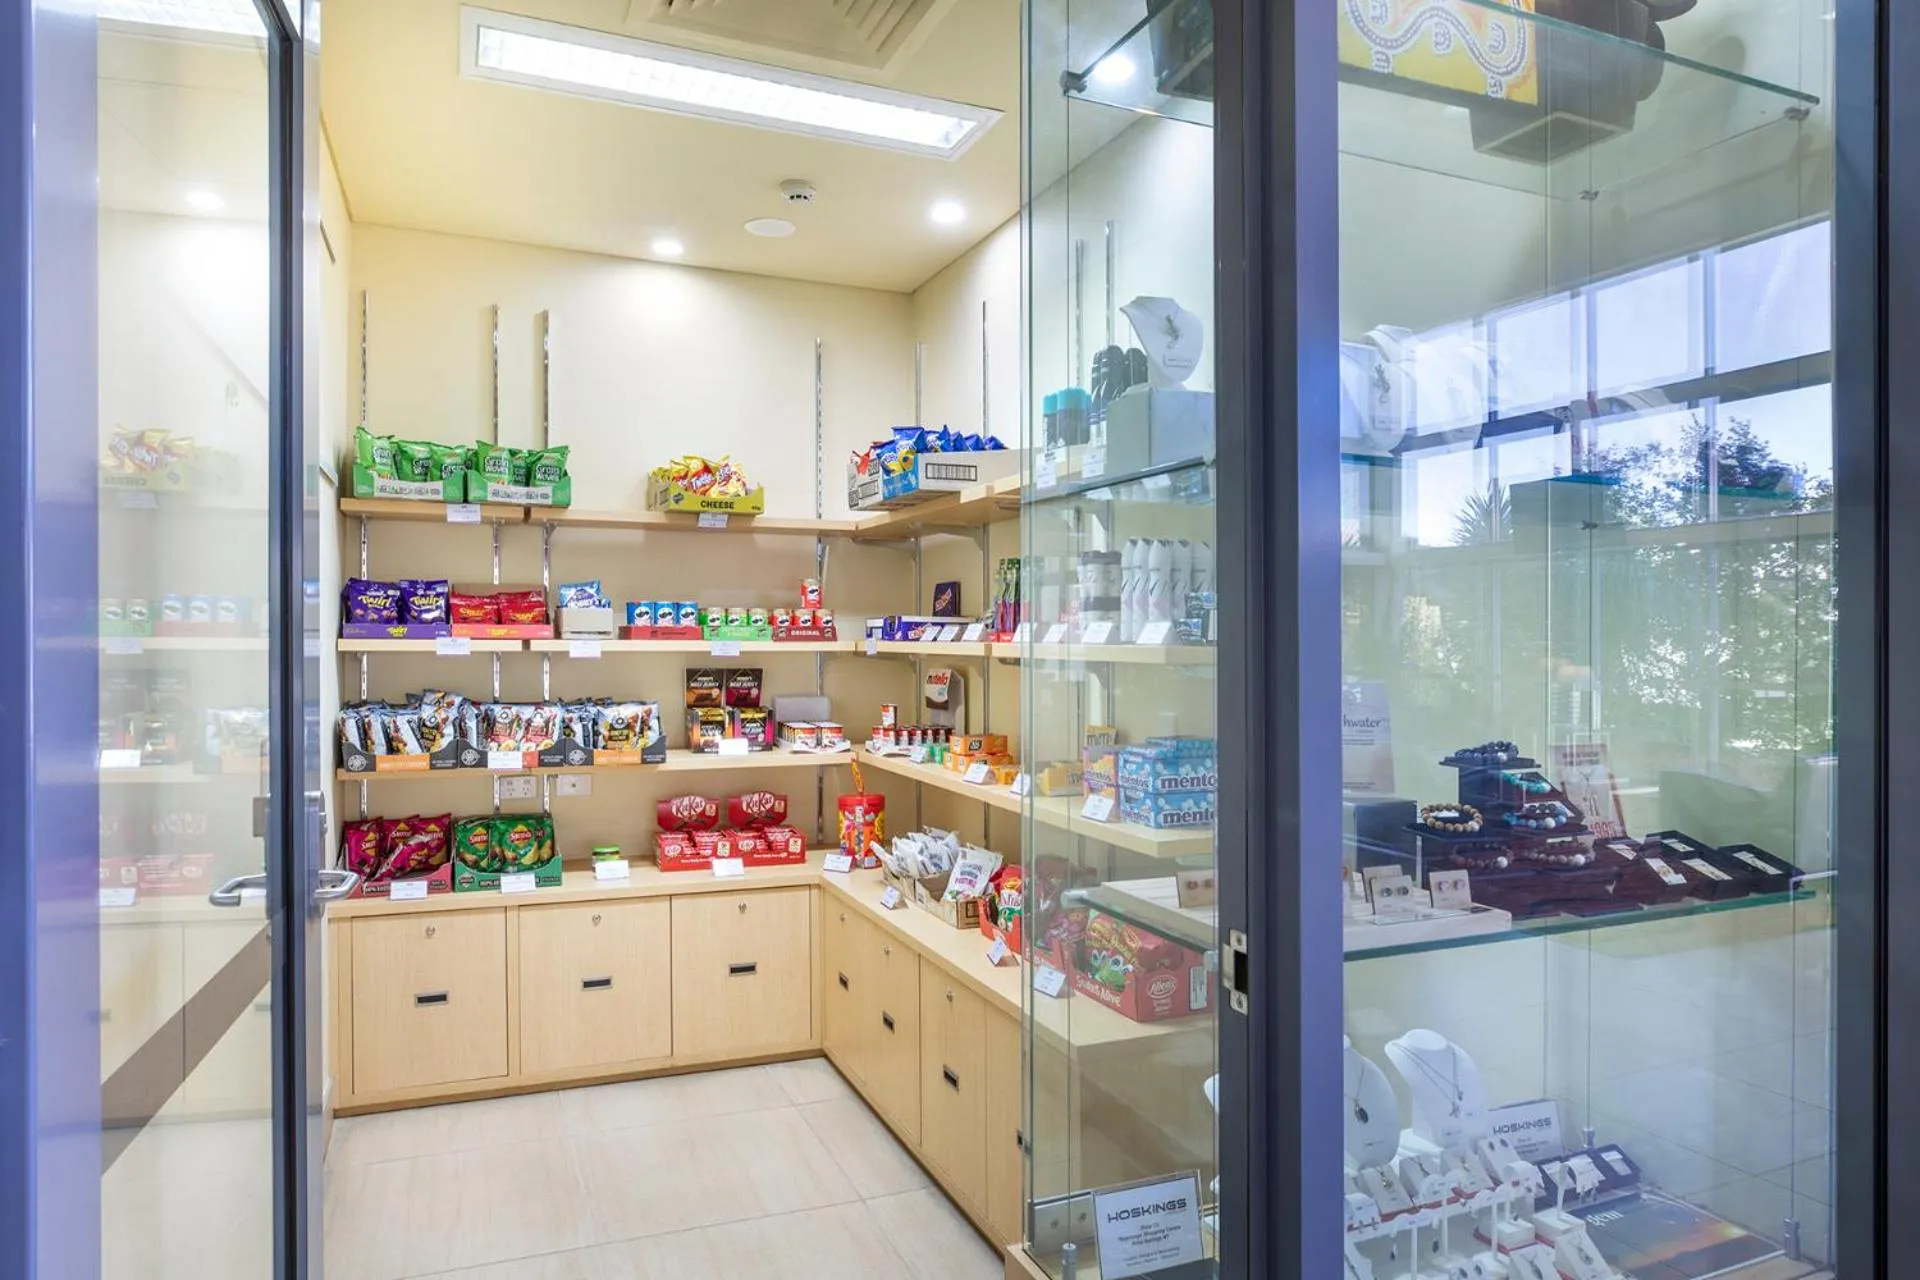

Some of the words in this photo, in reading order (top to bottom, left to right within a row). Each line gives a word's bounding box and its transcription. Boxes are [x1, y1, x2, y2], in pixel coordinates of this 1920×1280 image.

[700, 500, 735, 510] CHEESE
[358, 594, 393, 608] Twirl
[410, 594, 443, 606] Twirl
[927, 673, 948, 685] nutella
[1159, 773, 1218, 790] mento
[673, 796, 705, 815] KitKat
[743, 792, 774, 812] KitKat
[1493, 1117, 1552, 1135] HOSKINGS
[1107, 1198, 1187, 1223] HOSKINGS
